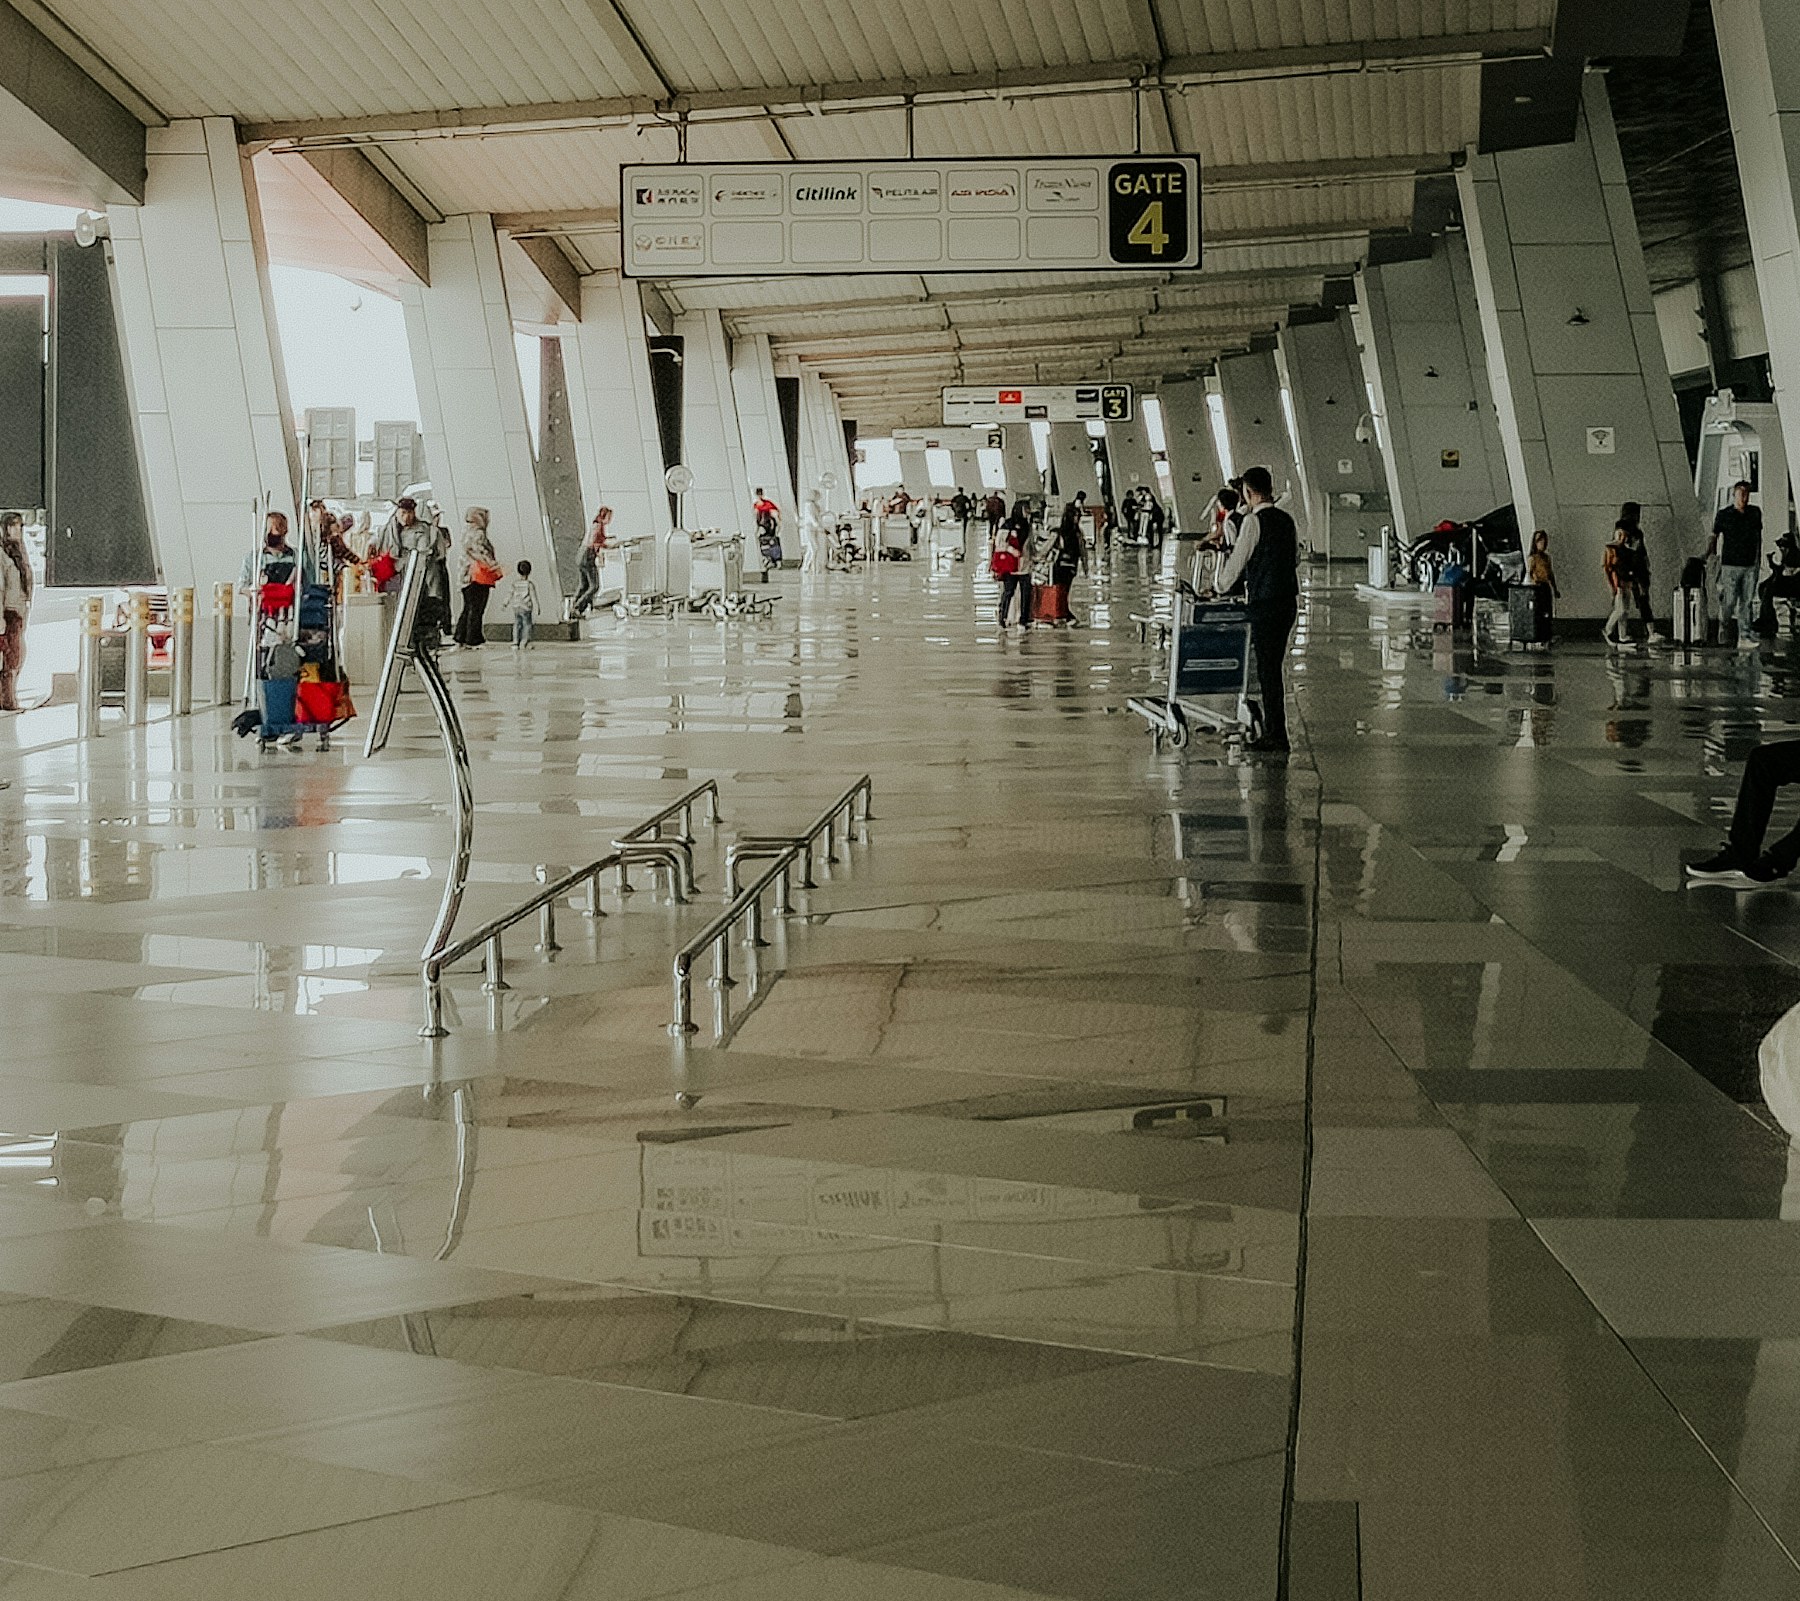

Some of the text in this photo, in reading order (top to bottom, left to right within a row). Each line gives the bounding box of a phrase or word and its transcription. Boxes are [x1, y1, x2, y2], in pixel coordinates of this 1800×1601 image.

[796, 187, 857, 201] Citilink
[1114, 173, 1182, 195] GATE
[1128, 201, 1169, 255] 4
[1108, 398, 1122, 418] 3
[990, 435, 1000, 449] 2
